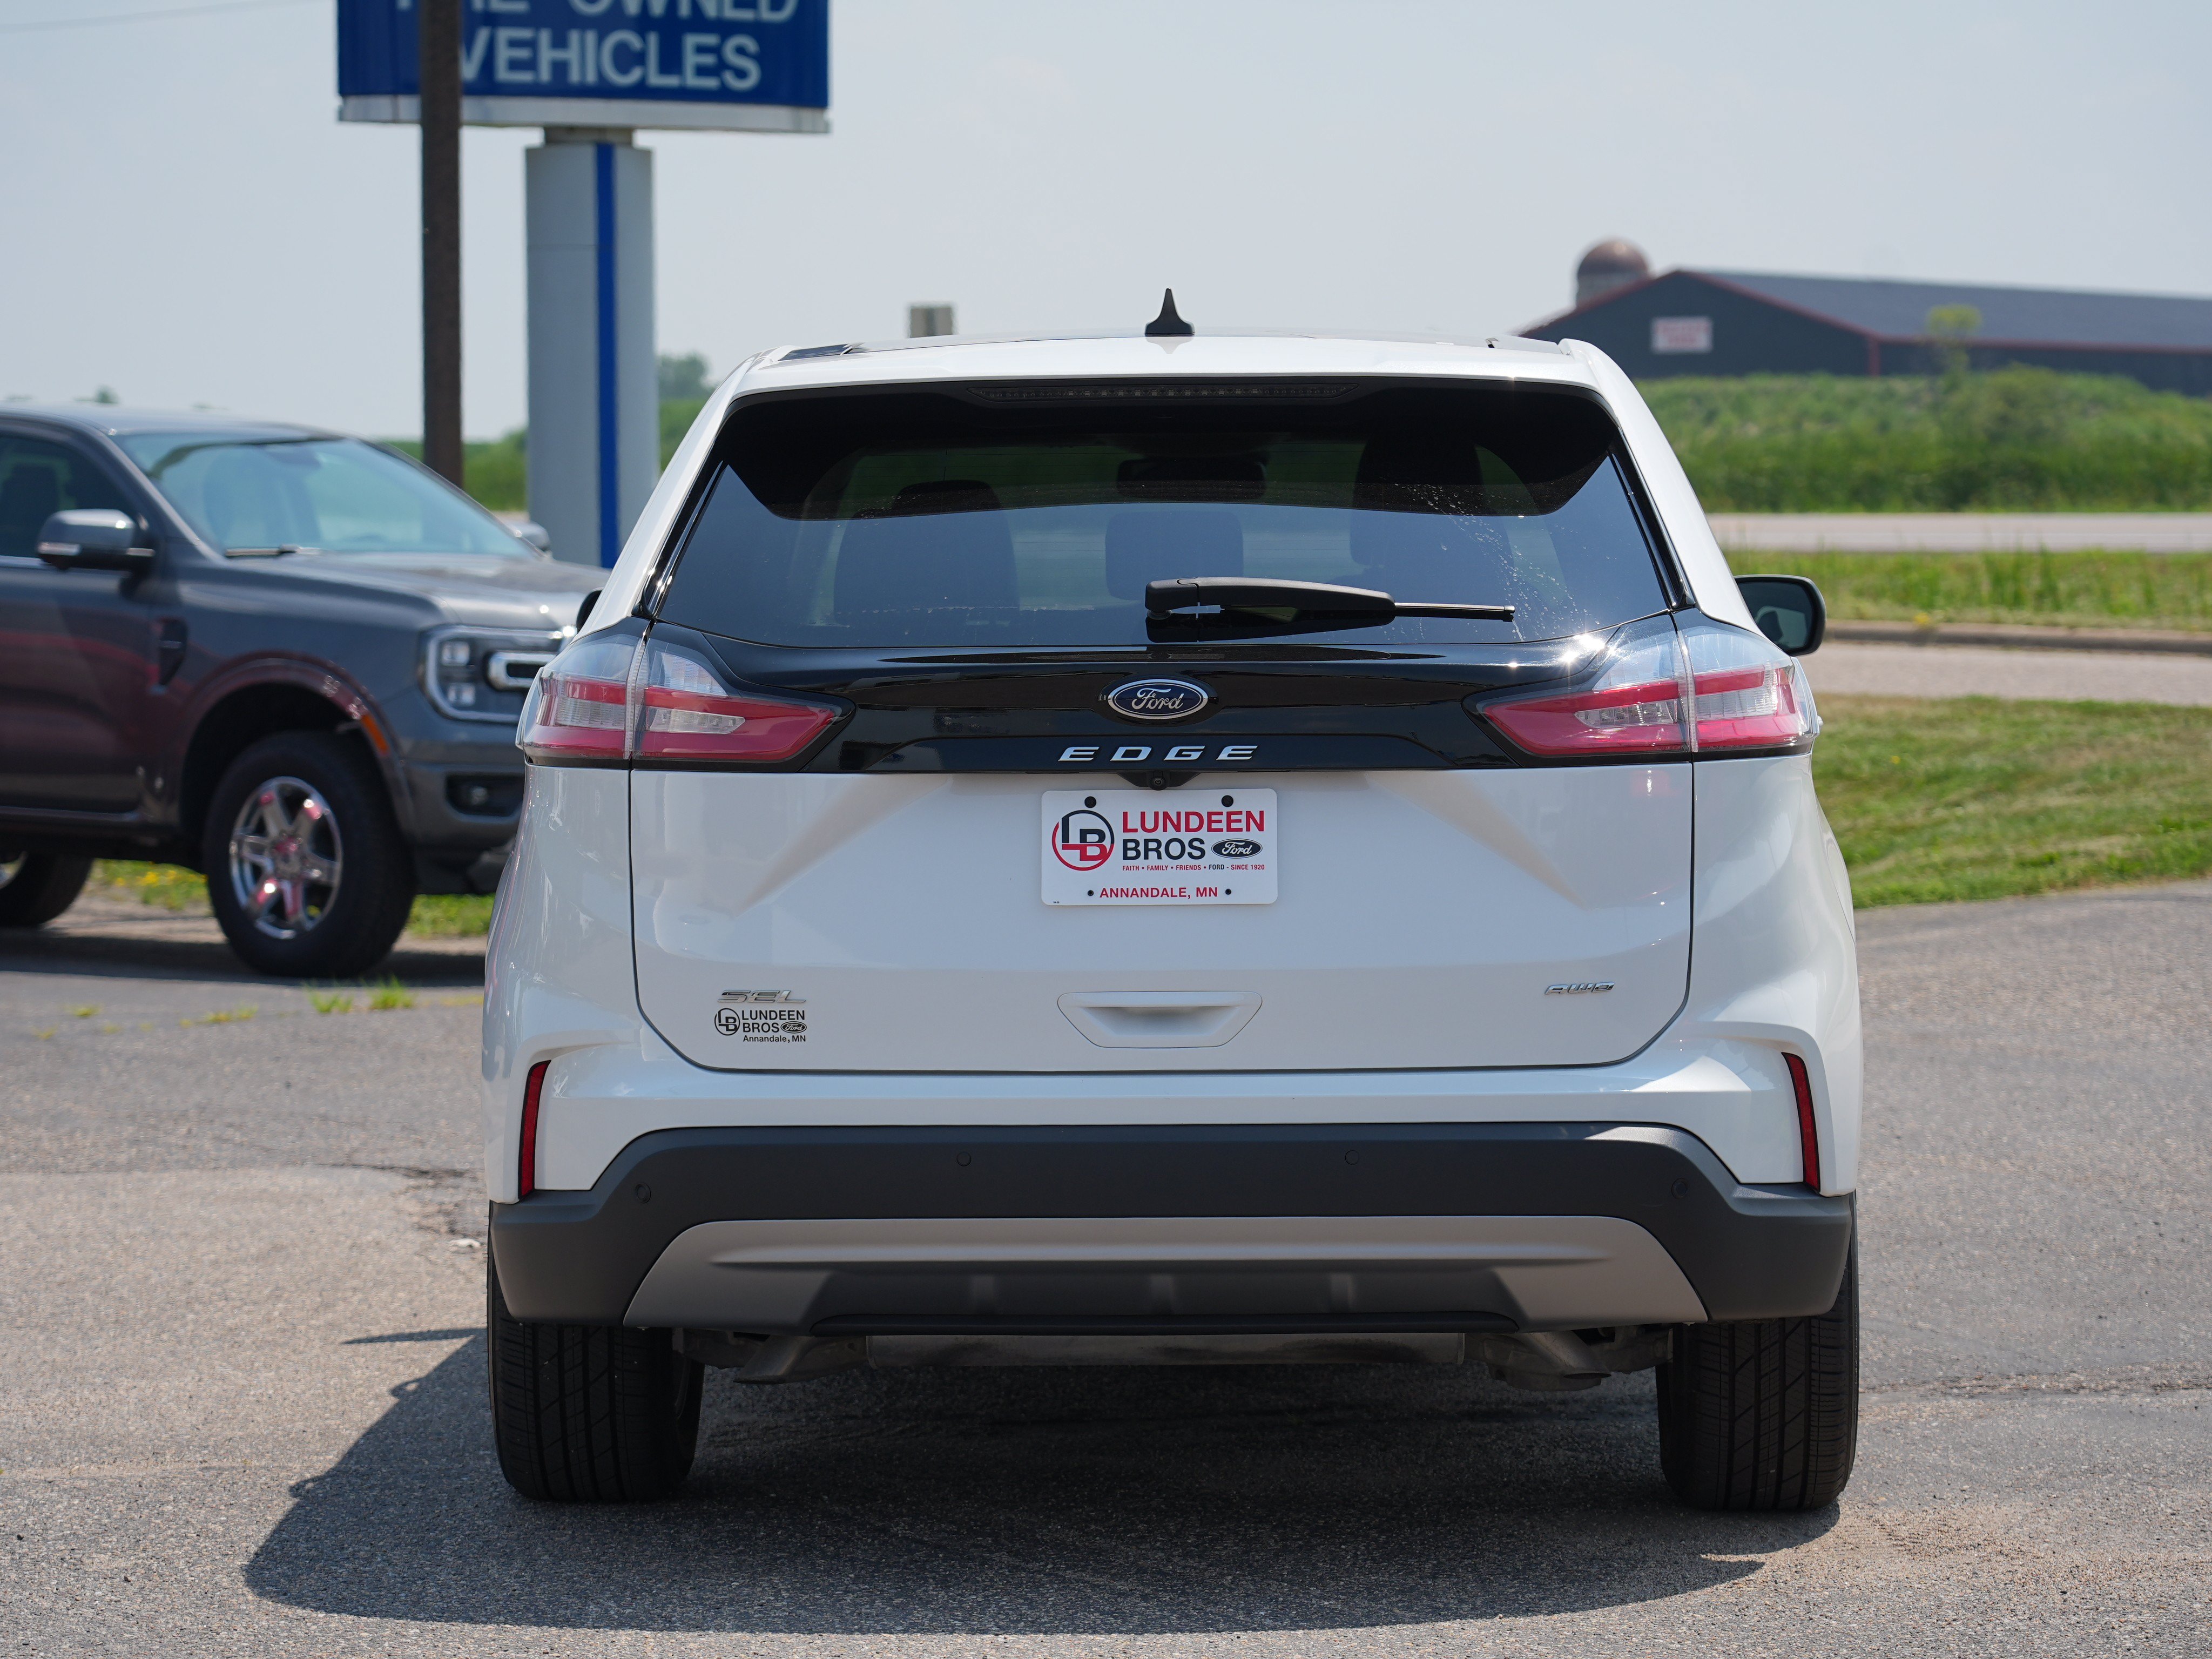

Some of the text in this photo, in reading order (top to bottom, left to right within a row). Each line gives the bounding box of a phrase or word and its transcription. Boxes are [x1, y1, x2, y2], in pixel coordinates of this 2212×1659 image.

[460, 26, 762, 90] VEHICLES
[1131, 688, 1185, 710] Ford
[1058, 745, 1258, 761] EDGE
[1122, 810, 1265, 833] LUNDEEN
[1122, 838, 1252, 860] BROS Ford
[1100, 887, 1218, 899] ANNANDALE, MN
[1545, 981, 1615, 995] AWD
[717, 989, 806, 1003] SEL
[742, 1010, 805, 1020] LUNDEEN
[743, 1022, 780, 1033] BROS
[743, 1035, 790, 1043] Annandale,
